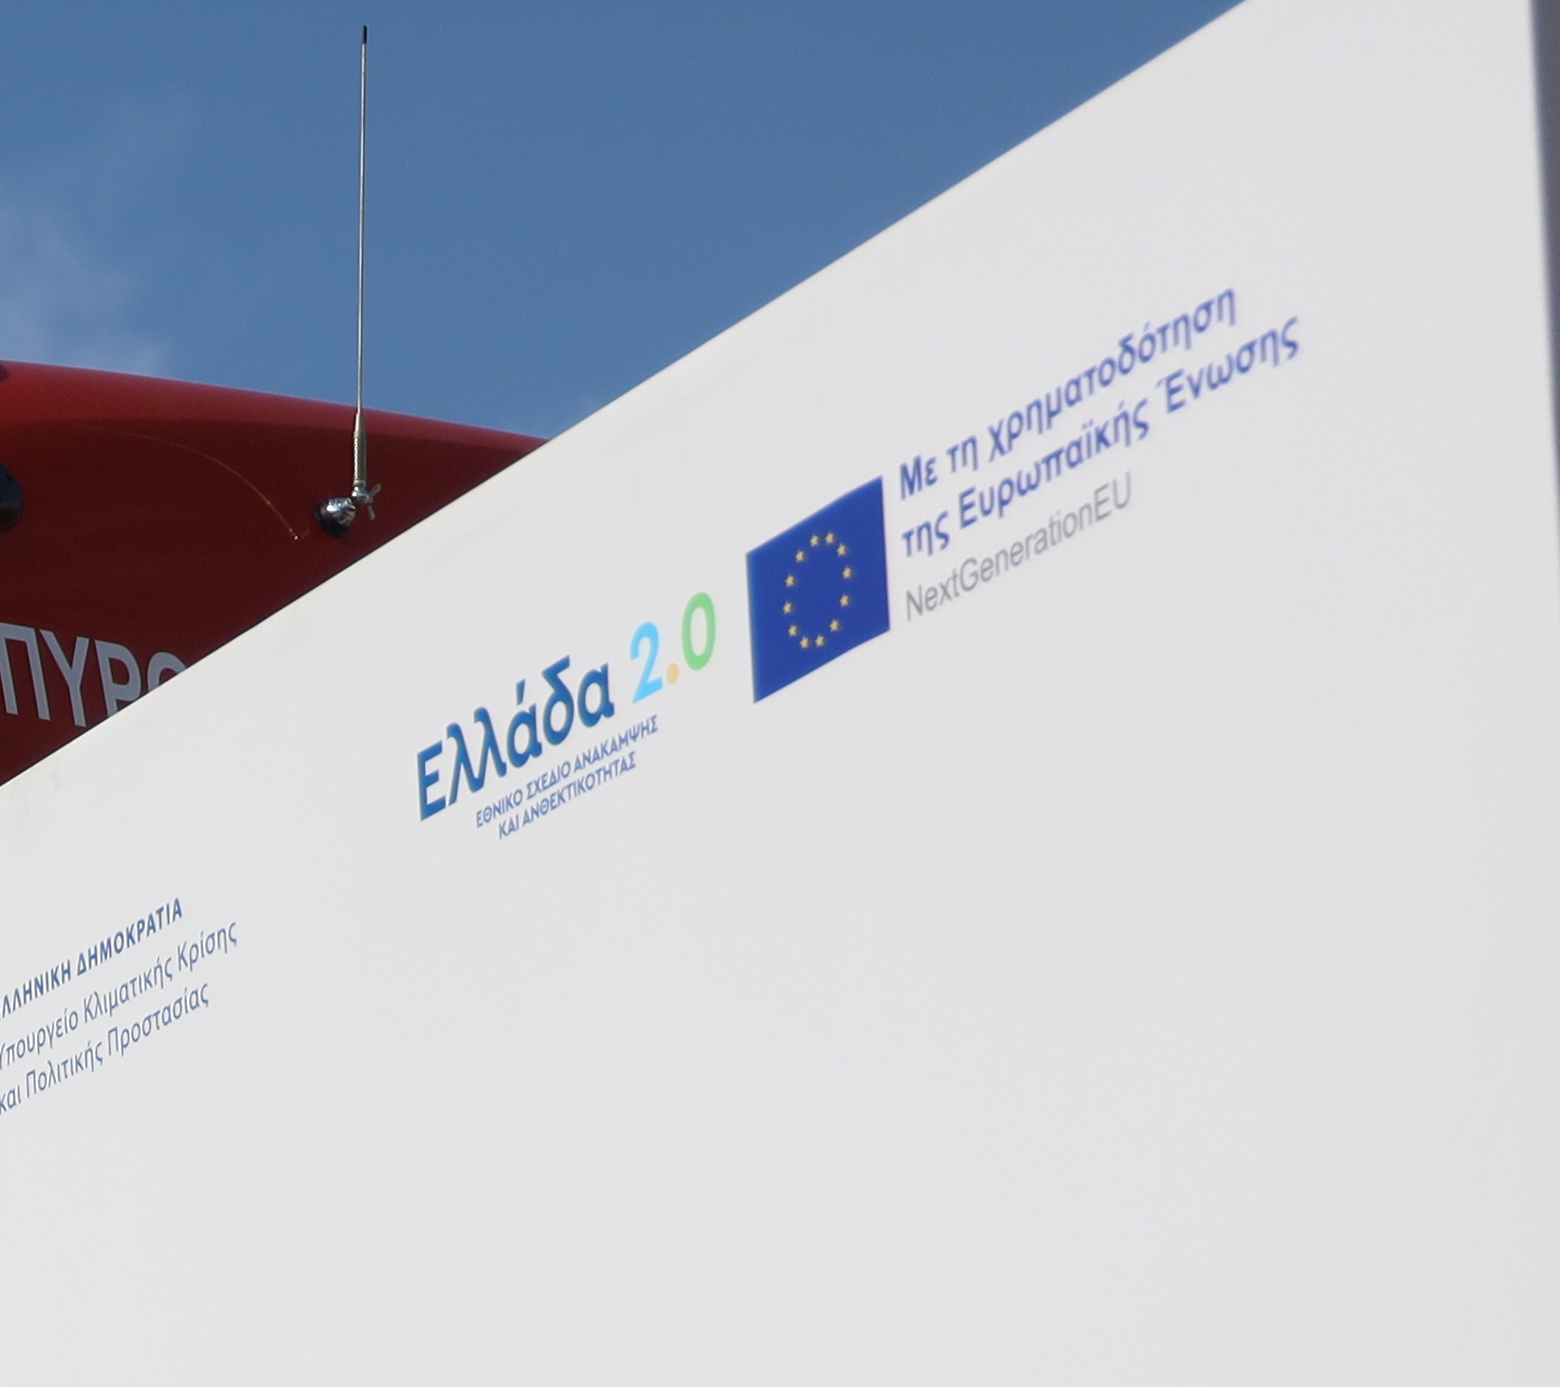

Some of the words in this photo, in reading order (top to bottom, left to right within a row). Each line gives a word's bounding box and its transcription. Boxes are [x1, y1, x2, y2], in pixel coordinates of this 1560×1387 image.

[899, 454, 938, 500] Με
[947, 435, 980, 472] τη
[987, 287, 1237, 462] χρηματοδότηση
[901, 511, 950, 558] της
[958, 397, 1151, 530] Ευρωπαϊκής
[1154, 316, 1300, 414] Ένωσης
[906, 471, 1133, 622] NextGenerationEU
[416, 653, 616, 822] Ελλάδα
[628, 591, 717, 706] 2.0
[475, 788, 524, 829] ΕΘΝΙΚΟ
[526, 760, 572, 800] ΣΧΕΔΙΟ
[573, 713, 659, 773] ΑΝΑΚΑΜΨΗΣ
[498, 812, 520, 840] ΚΑΙ
[521, 751, 638, 828] ΑΝΘΕΚΤΙΚΟΤΗΤΑΣ
[76, 897, 183, 976] ΔΗΜΟΚΡΑΤΙΑ
[83, 956, 174, 1024] Κλιματικής
[177, 921, 238, 973] Κρίσης
[26, 1040, 104, 1099] Πολιτικής
[107, 982, 210, 1057] Προστασίας
